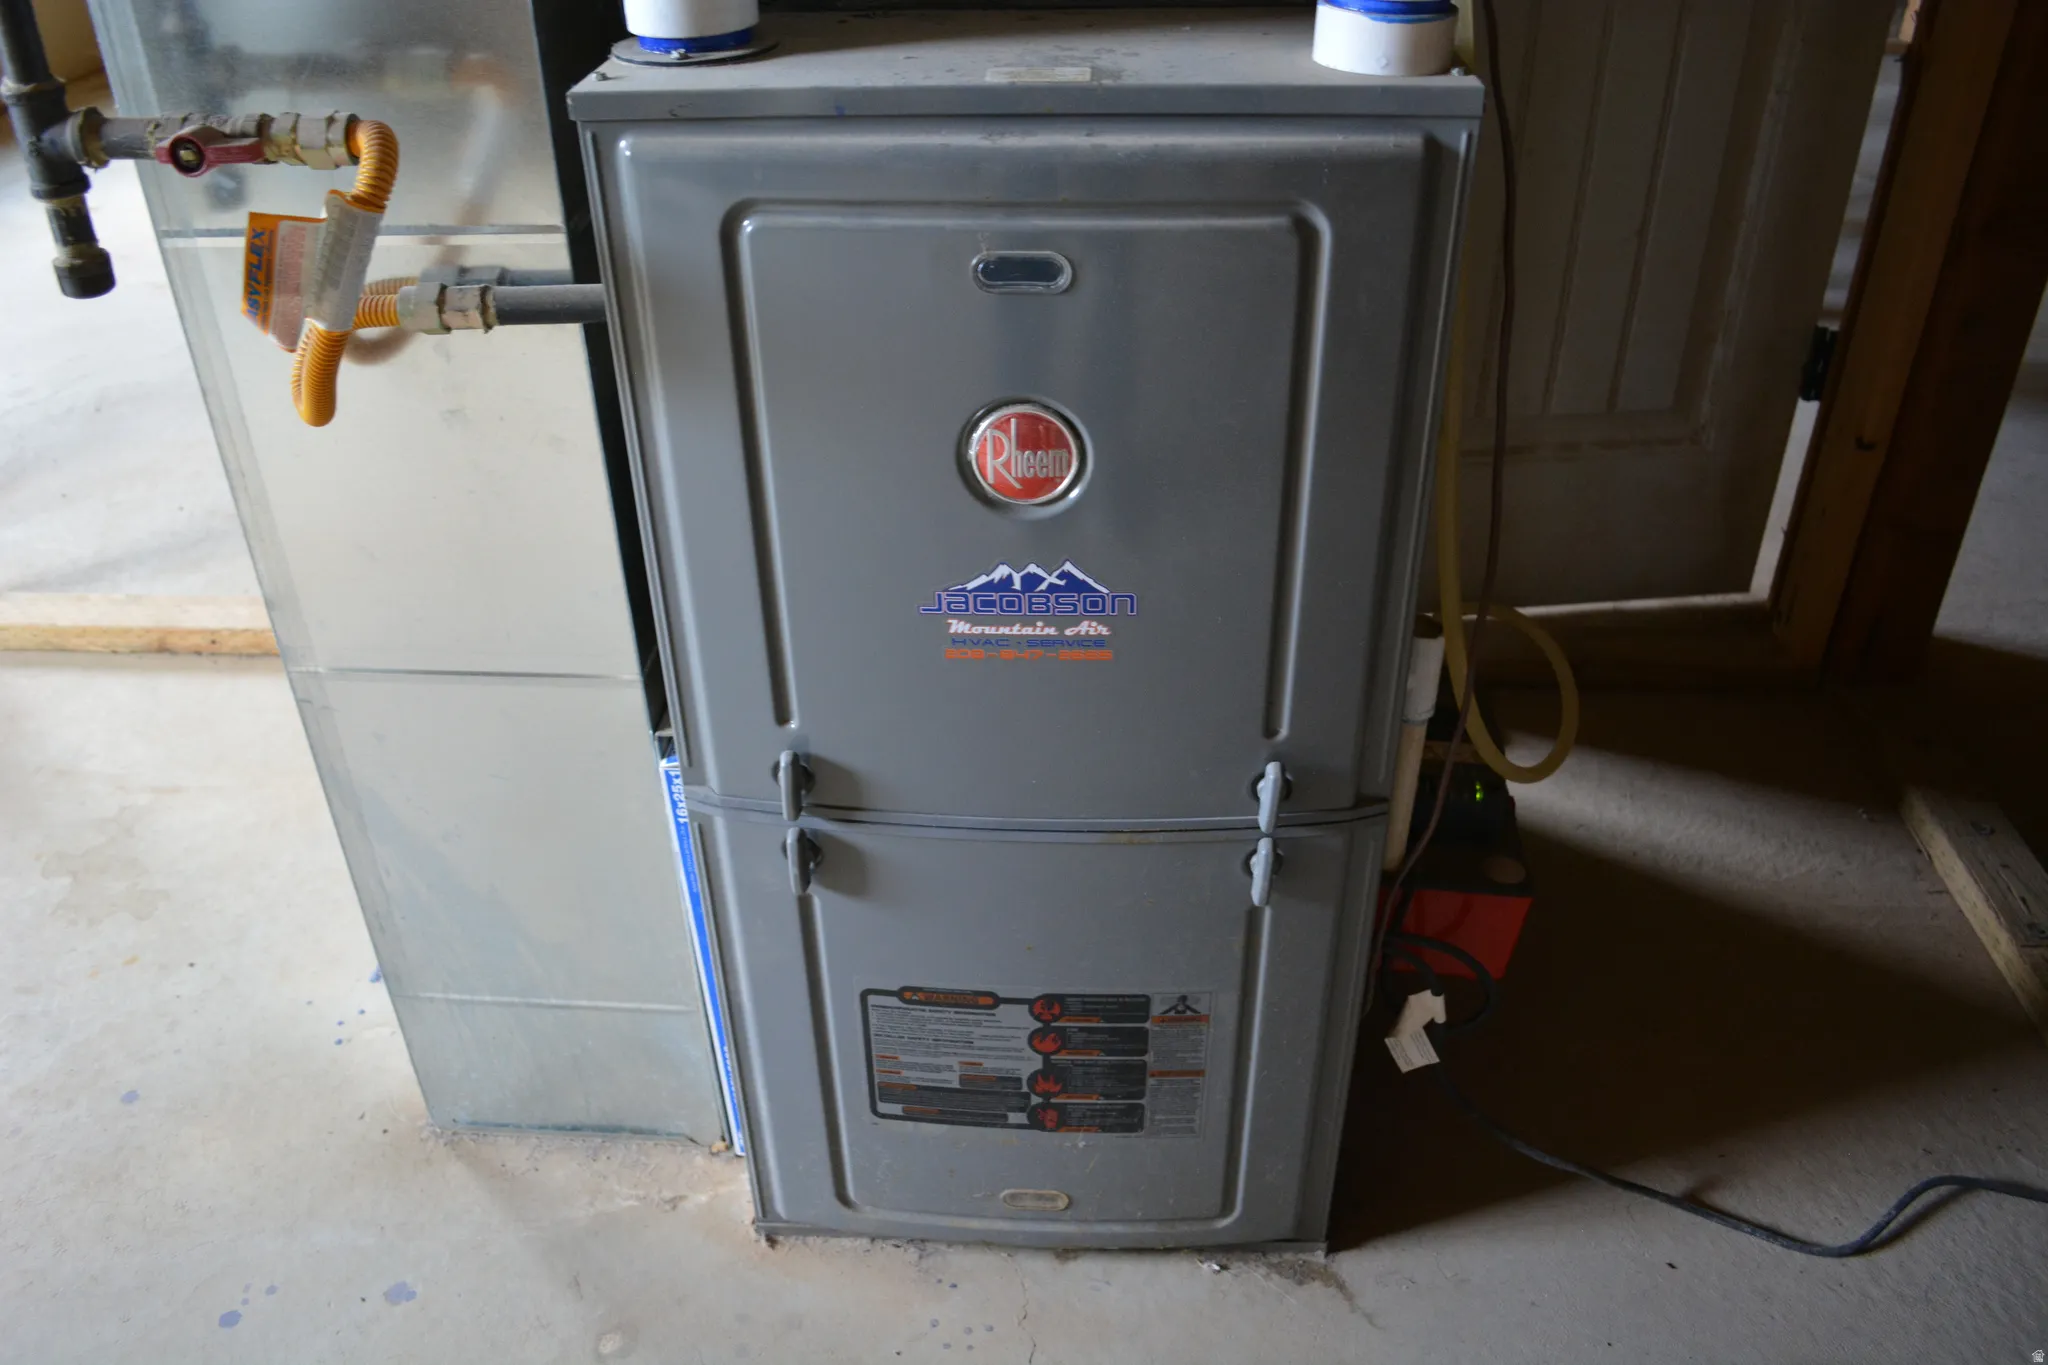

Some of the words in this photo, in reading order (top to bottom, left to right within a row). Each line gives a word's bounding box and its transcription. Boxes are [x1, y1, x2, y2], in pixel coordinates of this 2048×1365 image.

[985, 418, 1070, 489] Rheem
[945, 619, 1060, 636] Mountain
[1063, 620, 1112, 636] Air
[951, 638, 1011, 648] HVAC
[1025, 638, 1107, 648] SERVICE
